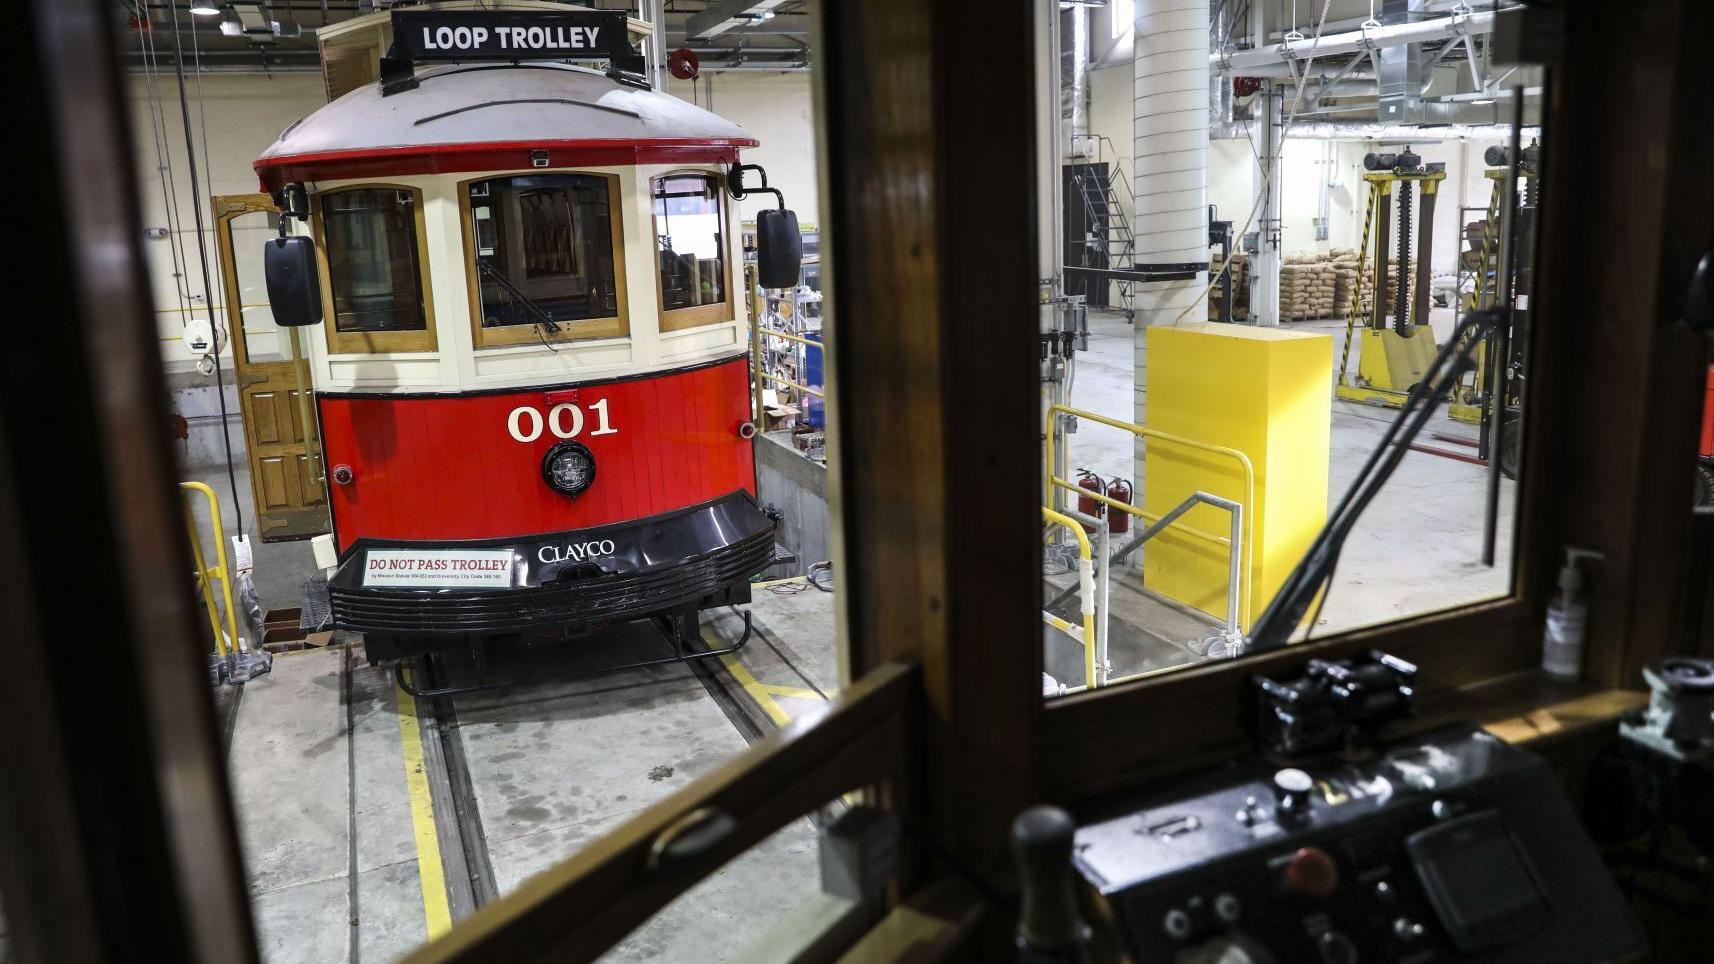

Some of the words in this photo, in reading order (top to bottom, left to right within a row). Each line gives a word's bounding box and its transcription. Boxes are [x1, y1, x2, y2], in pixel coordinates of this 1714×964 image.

[423, 26, 489, 50] LOOP
[494, 26, 600, 49] TROLLEY
[507, 398, 618, 443] 001
[537, 539, 615, 564] CLAYCO
[369, 559, 387, 570] DO
[388, 559, 416, 570] NOT
[416, 559, 448, 571] PASS
[451, 559, 508, 571] TROLLEY
